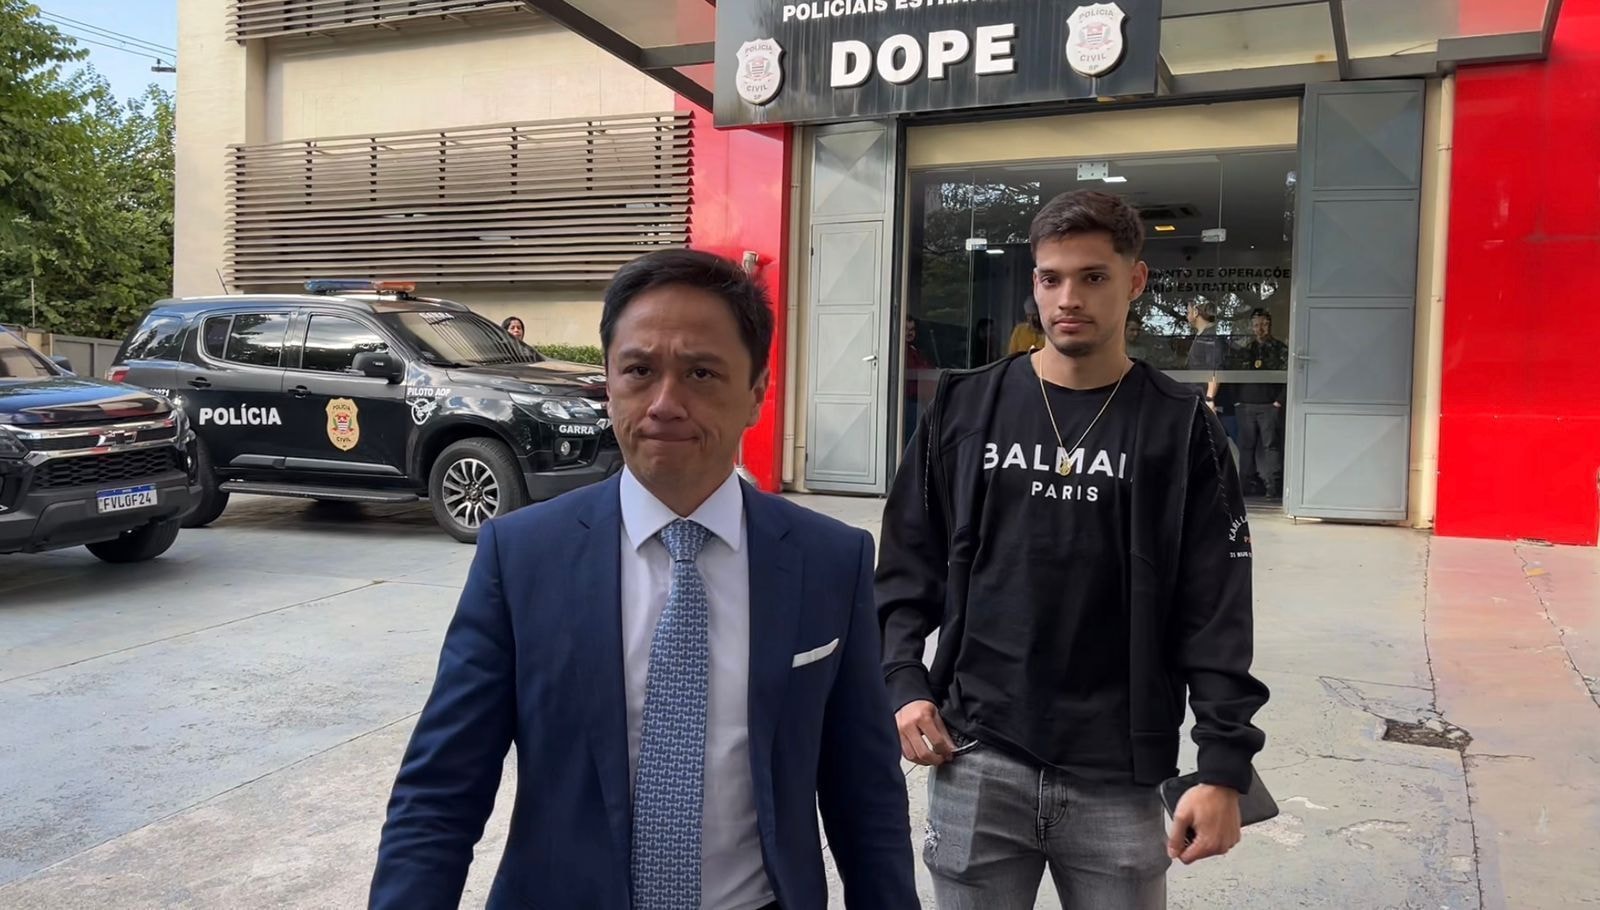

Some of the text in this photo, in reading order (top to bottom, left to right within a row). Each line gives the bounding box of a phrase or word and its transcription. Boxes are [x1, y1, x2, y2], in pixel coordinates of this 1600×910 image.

[783, 0, 888, 22] POLICIAIS
[830, 23, 1015, 88] DOPE
[1080, 53, 1106, 62] CIVIL
[746, 84, 768, 92] CIVIL
[1196, 268, 1215, 278] DE
[407, 387, 434, 396] PILOTO
[199, 403, 282, 426] POLÍCIA
[558, 424, 595, 435] GARRA
[983, 442, 1128, 479] BALMAI
[1031, 480, 1099, 502] PARIS
[1228, 519, 1242, 542] KARL
